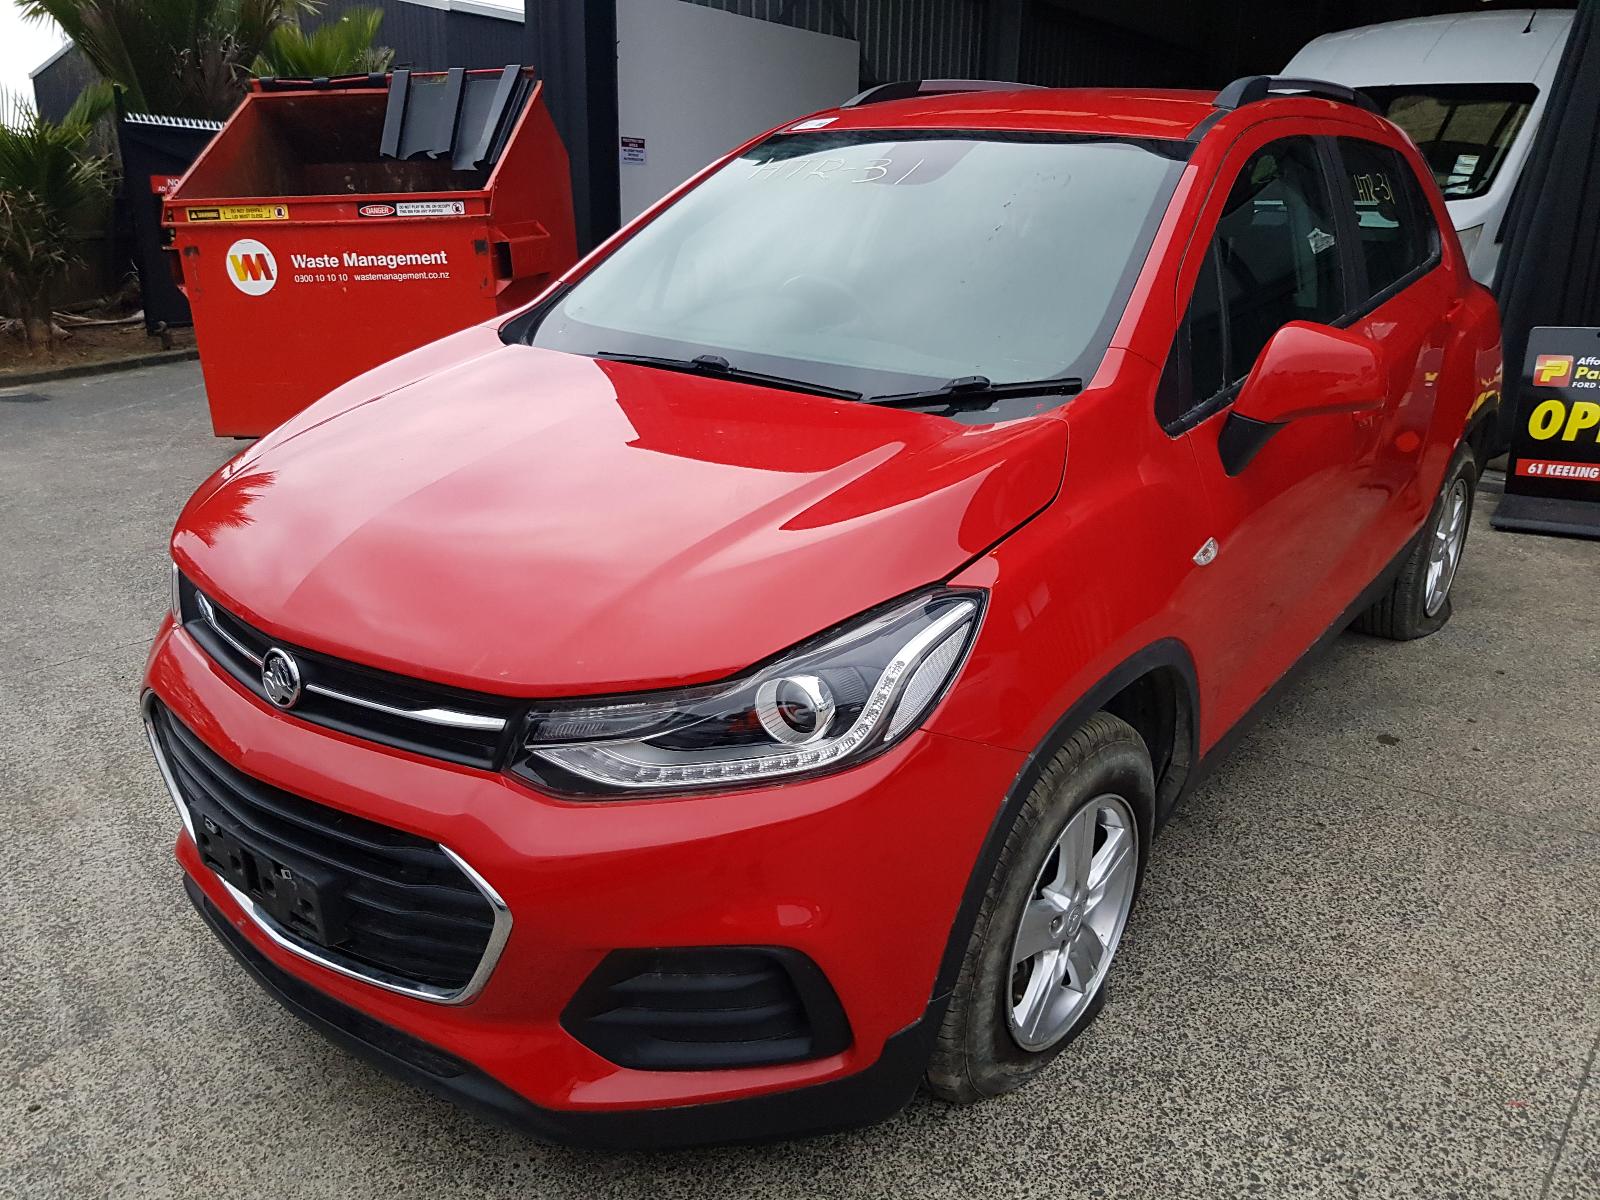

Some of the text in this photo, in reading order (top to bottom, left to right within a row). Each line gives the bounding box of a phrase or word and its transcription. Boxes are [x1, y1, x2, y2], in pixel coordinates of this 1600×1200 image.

[366, 207, 389, 215] DANGER
[291, 251, 448, 269] Waste Management
[315, 274, 325, 282] 10
[326, 273, 337, 282] 10
[338, 273, 348, 282] 10
[354, 271, 450, 282] wastemanagement.co.nz
[1575, 366, 1600, 380] Pa
[1572, 381, 1597, 389] FORD
[1528, 399, 1600, 443] OP
[1527, 463, 1600, 479] 61 KEELING
